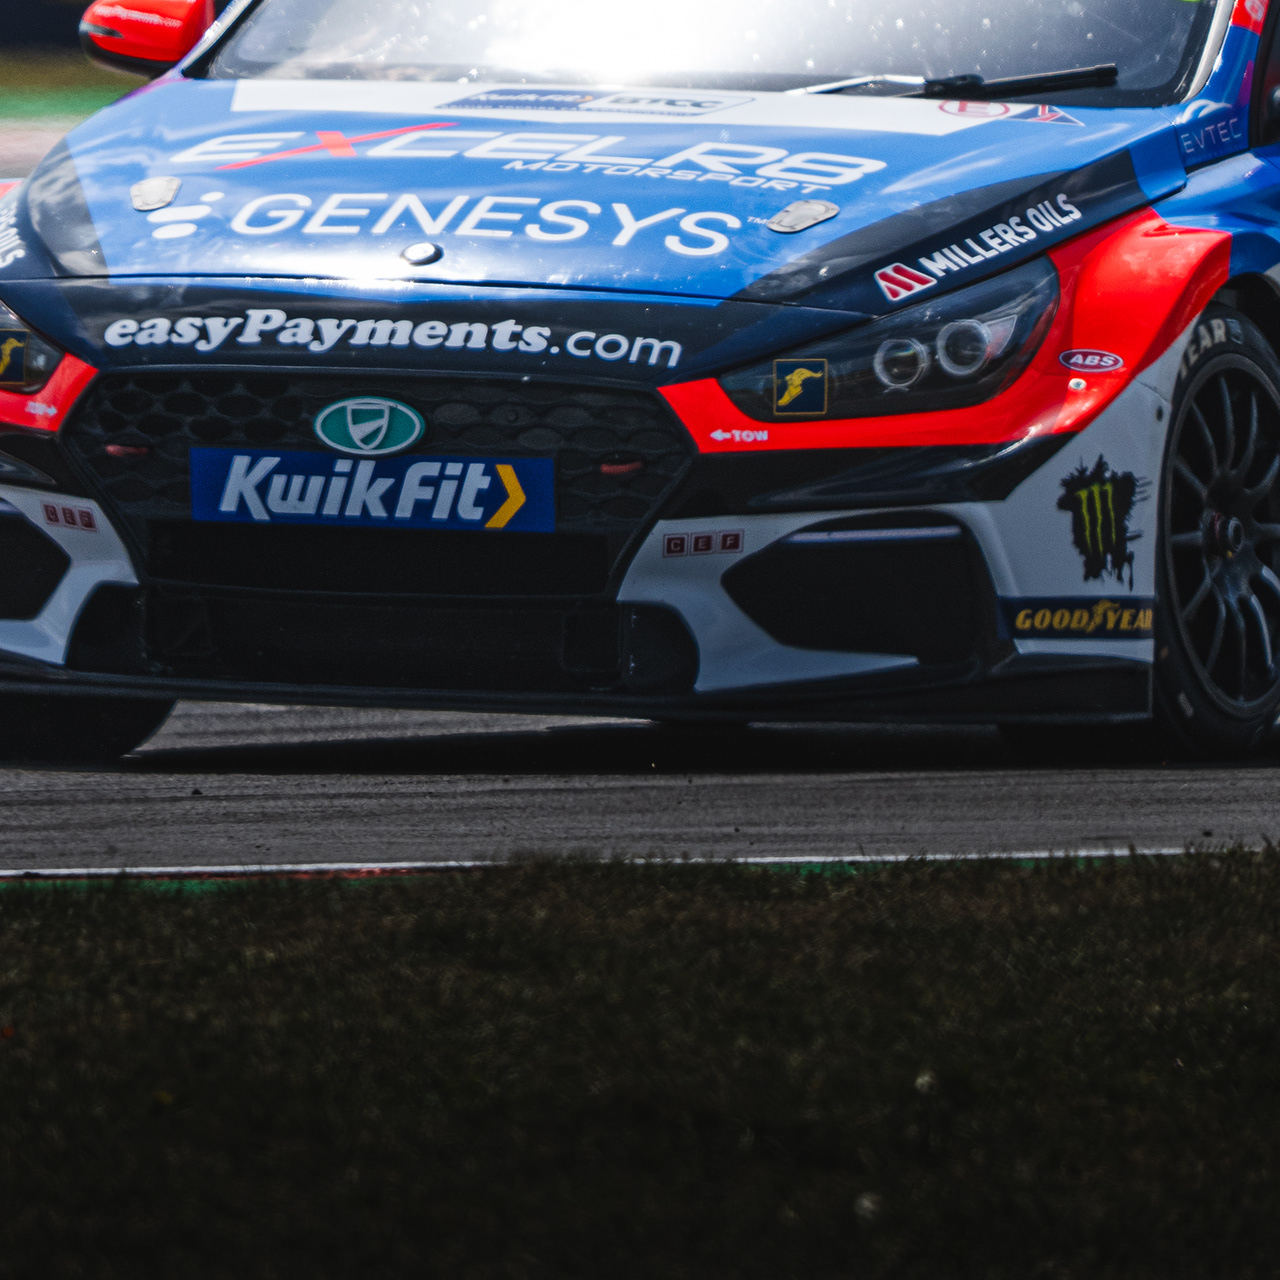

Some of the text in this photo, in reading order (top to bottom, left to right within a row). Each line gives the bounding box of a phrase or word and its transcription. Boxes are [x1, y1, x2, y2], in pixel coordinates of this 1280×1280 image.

[169, 121, 888, 187] EXCELR8
[1180, 117, 1243, 154] EVTEC
[501, 160, 833, 194] MOTORSPORT
[229, 192, 742, 257] GENESYS
[917, 192, 1083, 278] MILLERS OILS
[103, 308, 683, 369] easyPayments.com
[1069, 353, 1114, 368] ABS
[732, 428, 770, 443] TOW
[1015, 606, 1153, 632] GOODYEAR
